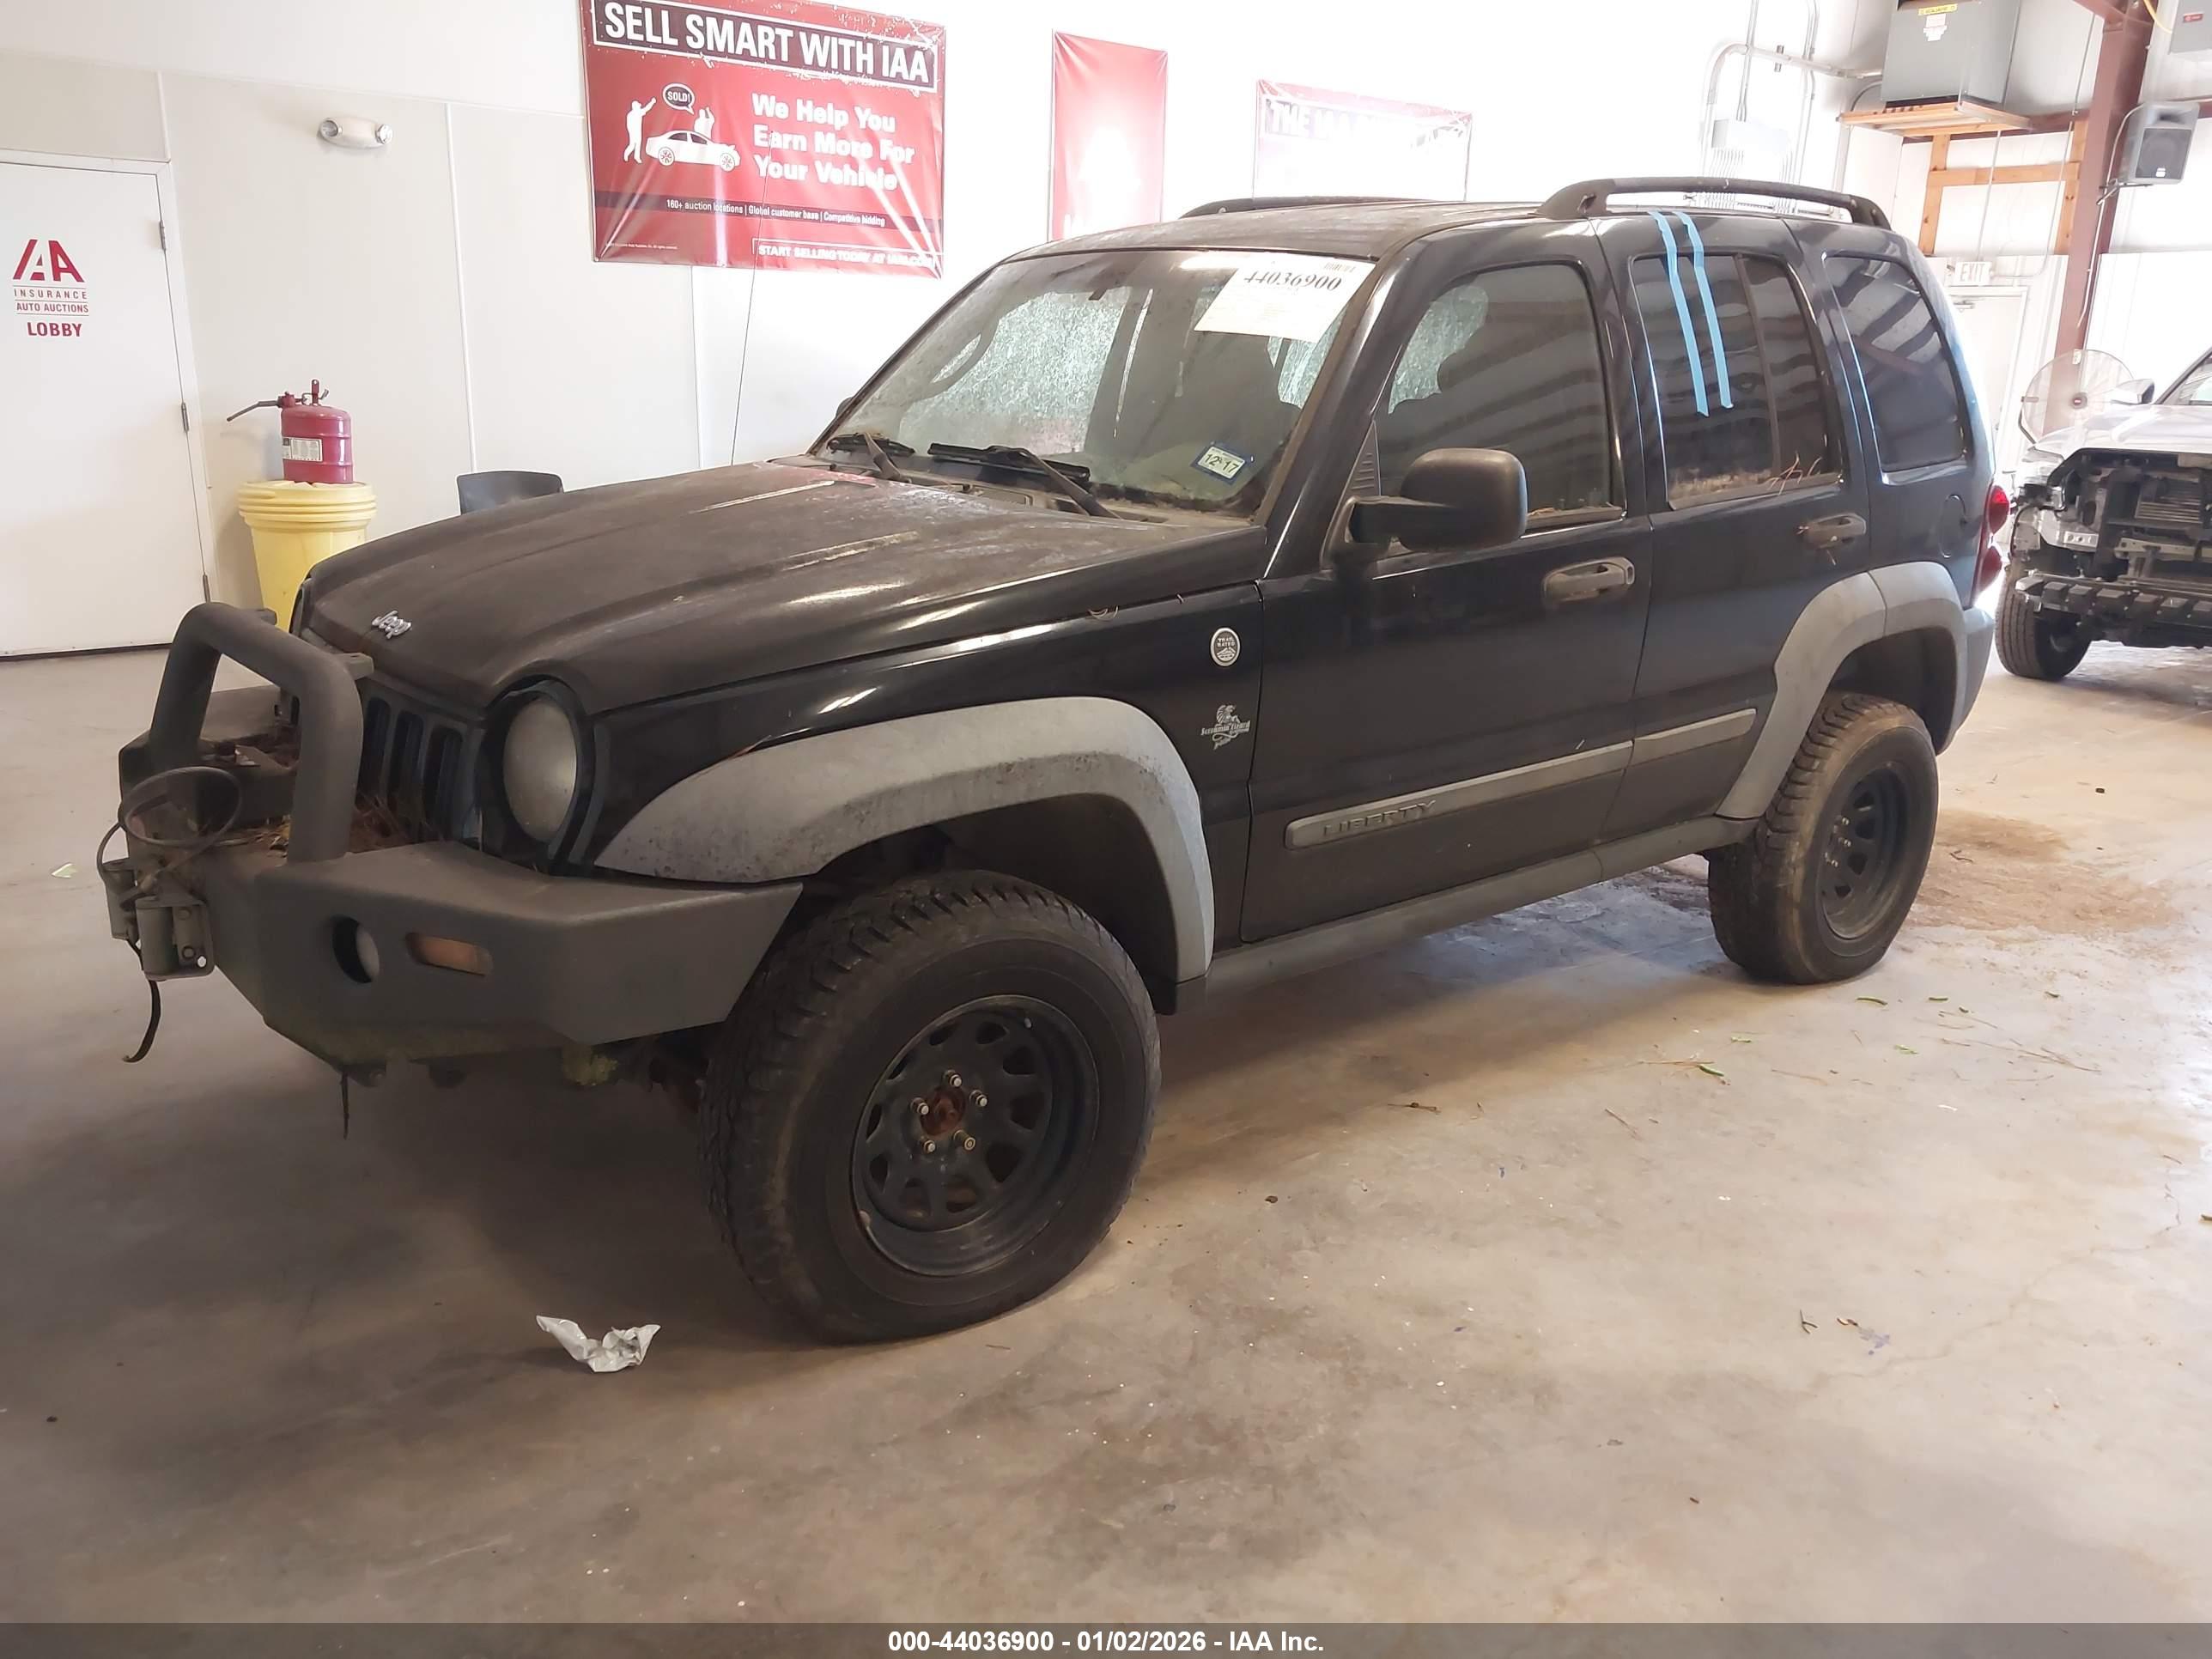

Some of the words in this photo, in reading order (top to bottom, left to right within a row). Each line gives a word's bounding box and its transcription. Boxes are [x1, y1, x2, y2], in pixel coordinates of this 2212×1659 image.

[605, 2, 678, 46] SELL
[686, 14, 794, 62] SMART
[799, 31, 874, 75] WITH
[882, 45, 929, 83] IAA
[667, 90, 690, 103] SOLD!
[751, 93, 789, 119] We
[796, 99, 849, 131] Help
[854, 106, 896, 133] You
[753, 124, 808, 152] Earn
[814, 131, 873, 160] More
[879, 138, 915, 164] For
[753, 154, 809, 181] Your
[666, 198, 684, 210] 160+
[684, 201, 712, 211] auction
[713, 202, 744, 214] locations
[748, 204, 770, 216] Global
[770, 208, 802, 219] customer
[802, 210, 819, 221] base
[758, 244, 792, 258] START
[793, 246, 836, 261] SELLING
[1243, 270, 1342, 291] 44036900
[1960, 263, 1986, 283] EXIT
[14, 289, 88, 300] INSURANCE
[16, 302, 41, 312] AUTO
[43, 303, 89, 313] AUCTIONS
[27, 321, 82, 337] LOBBY
[372, 610, 411, 640] Jeep
[1323, 799, 1436, 836] LIBERTY
